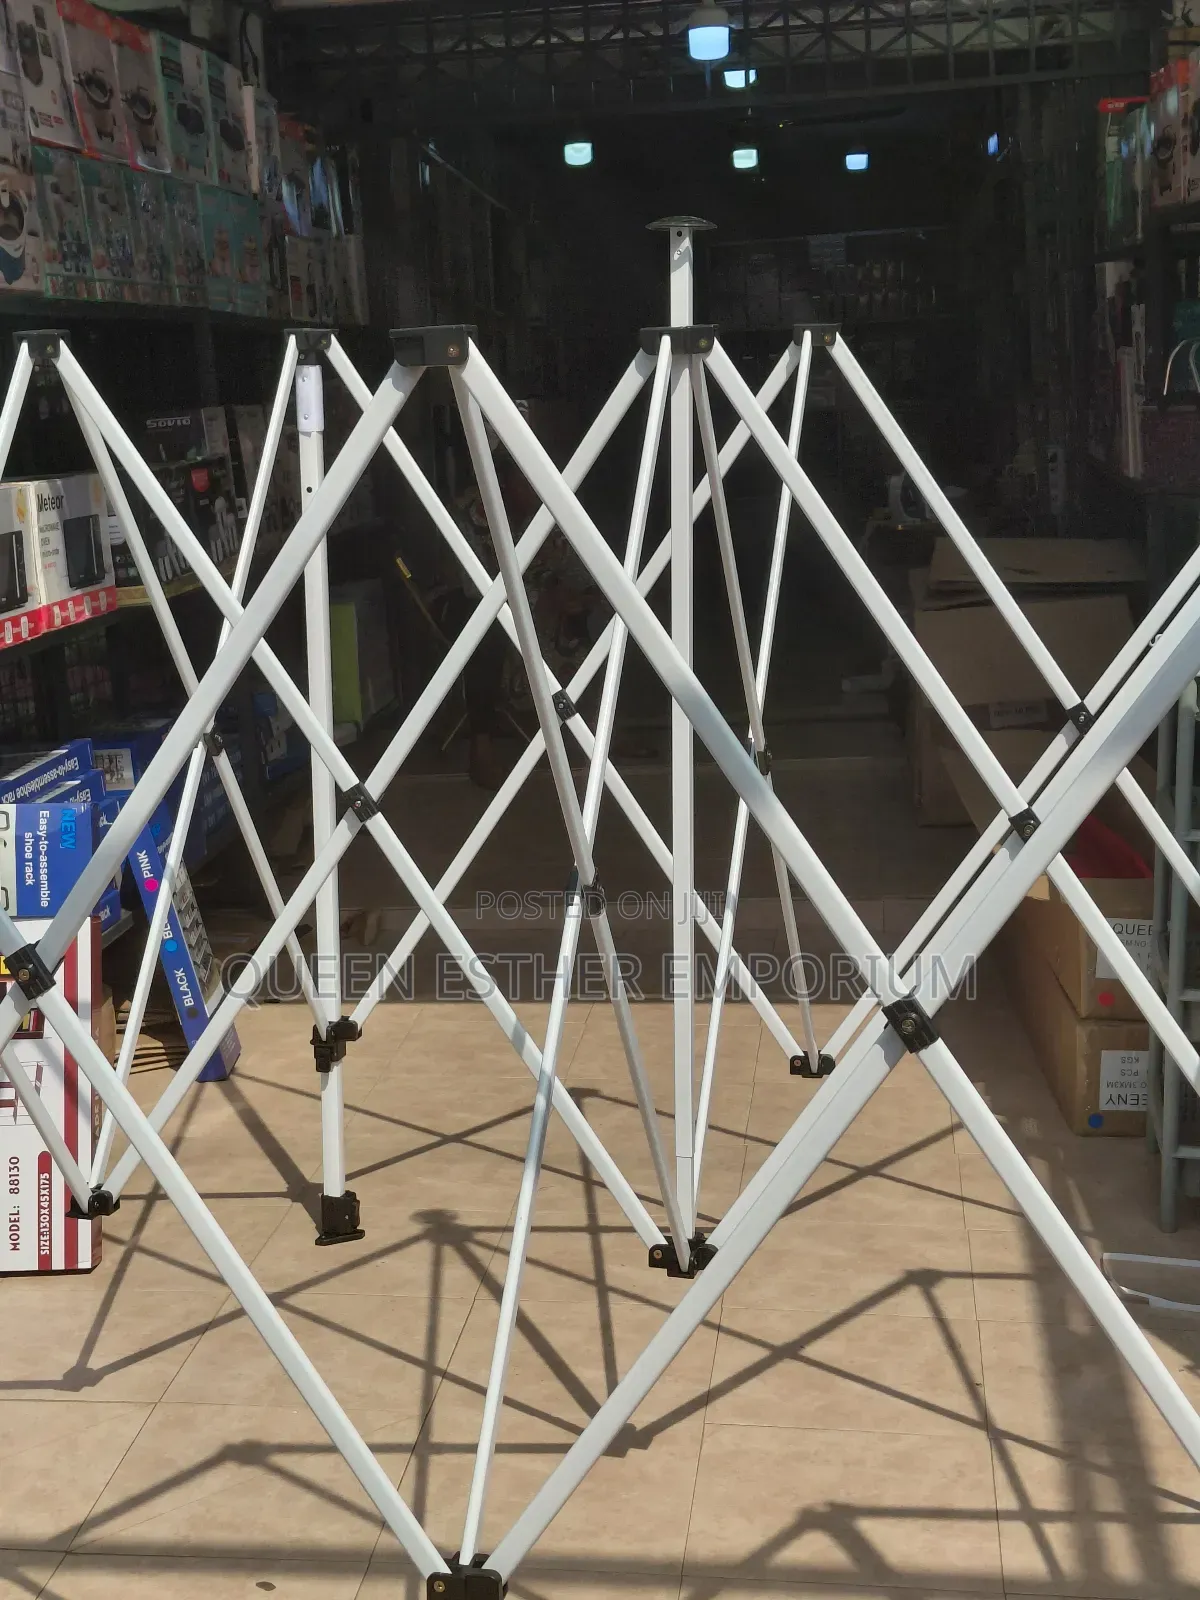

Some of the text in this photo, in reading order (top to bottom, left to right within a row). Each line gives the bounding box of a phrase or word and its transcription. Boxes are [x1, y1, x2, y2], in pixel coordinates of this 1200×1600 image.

[37, 493, 64, 512] Meteor
[60, 808, 76, 849] NEW
[25, 832, 35, 886] shoe rack
[38, 810, 50, 908] Easy-to-assemble
[136, 850, 154, 878] PINK
[1113, 923, 1153, 935] QUEE
[173, 967, 195, 1007] BLACK
[1121, 1056, 1140, 1064] KGS
[1121, 1069, 1139, 1077] PCS
[1105, 1094, 1148, 1106] EENY
[9, 1156, 20, 1251] MODEL: 88130
[40, 1172, 50, 1255] SIZE:130X45X175
